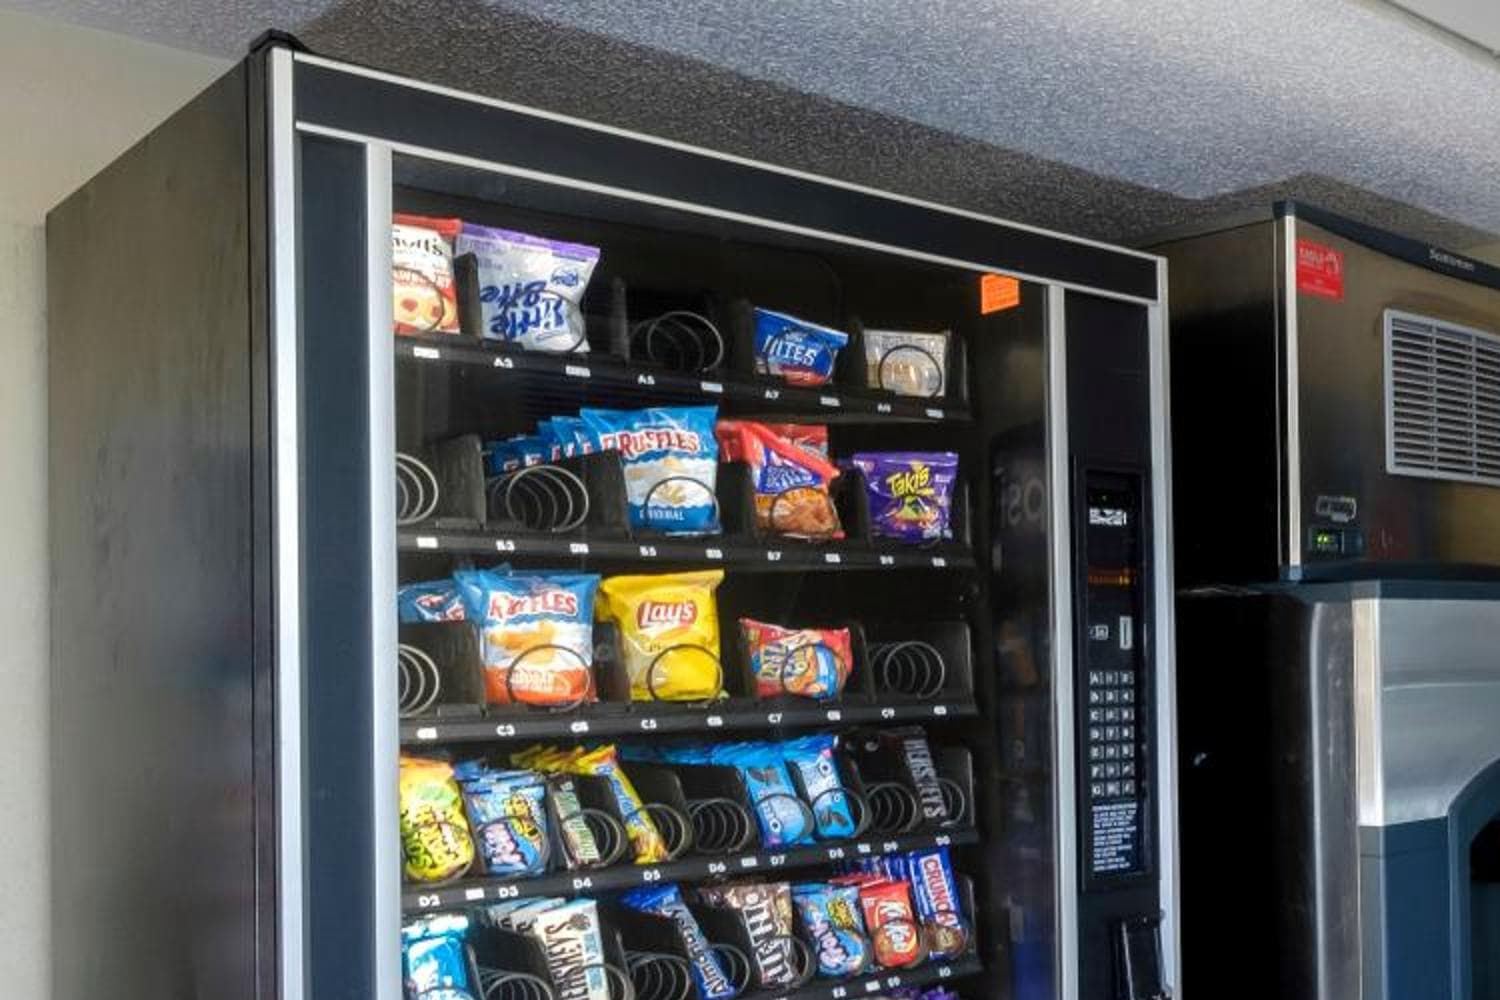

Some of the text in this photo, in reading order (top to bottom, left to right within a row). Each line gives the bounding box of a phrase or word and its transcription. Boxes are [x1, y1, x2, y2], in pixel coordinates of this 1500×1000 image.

[617, 429, 699, 459] RUFFLES
[886, 465, 931, 496] Takis
[639, 601, 696, 629] Lay's
[640, 718, 658, 730] C5
[767, 712, 783, 724] C7
[495, 723, 516, 737] C3
[770, 854, 786, 866] D7
[708, 861, 727, 874] D6
[642, 868, 661, 882] D5
[572, 876, 593, 890] D4
[497, 884, 520, 899] D3
[417, 893, 441, 908] D2
